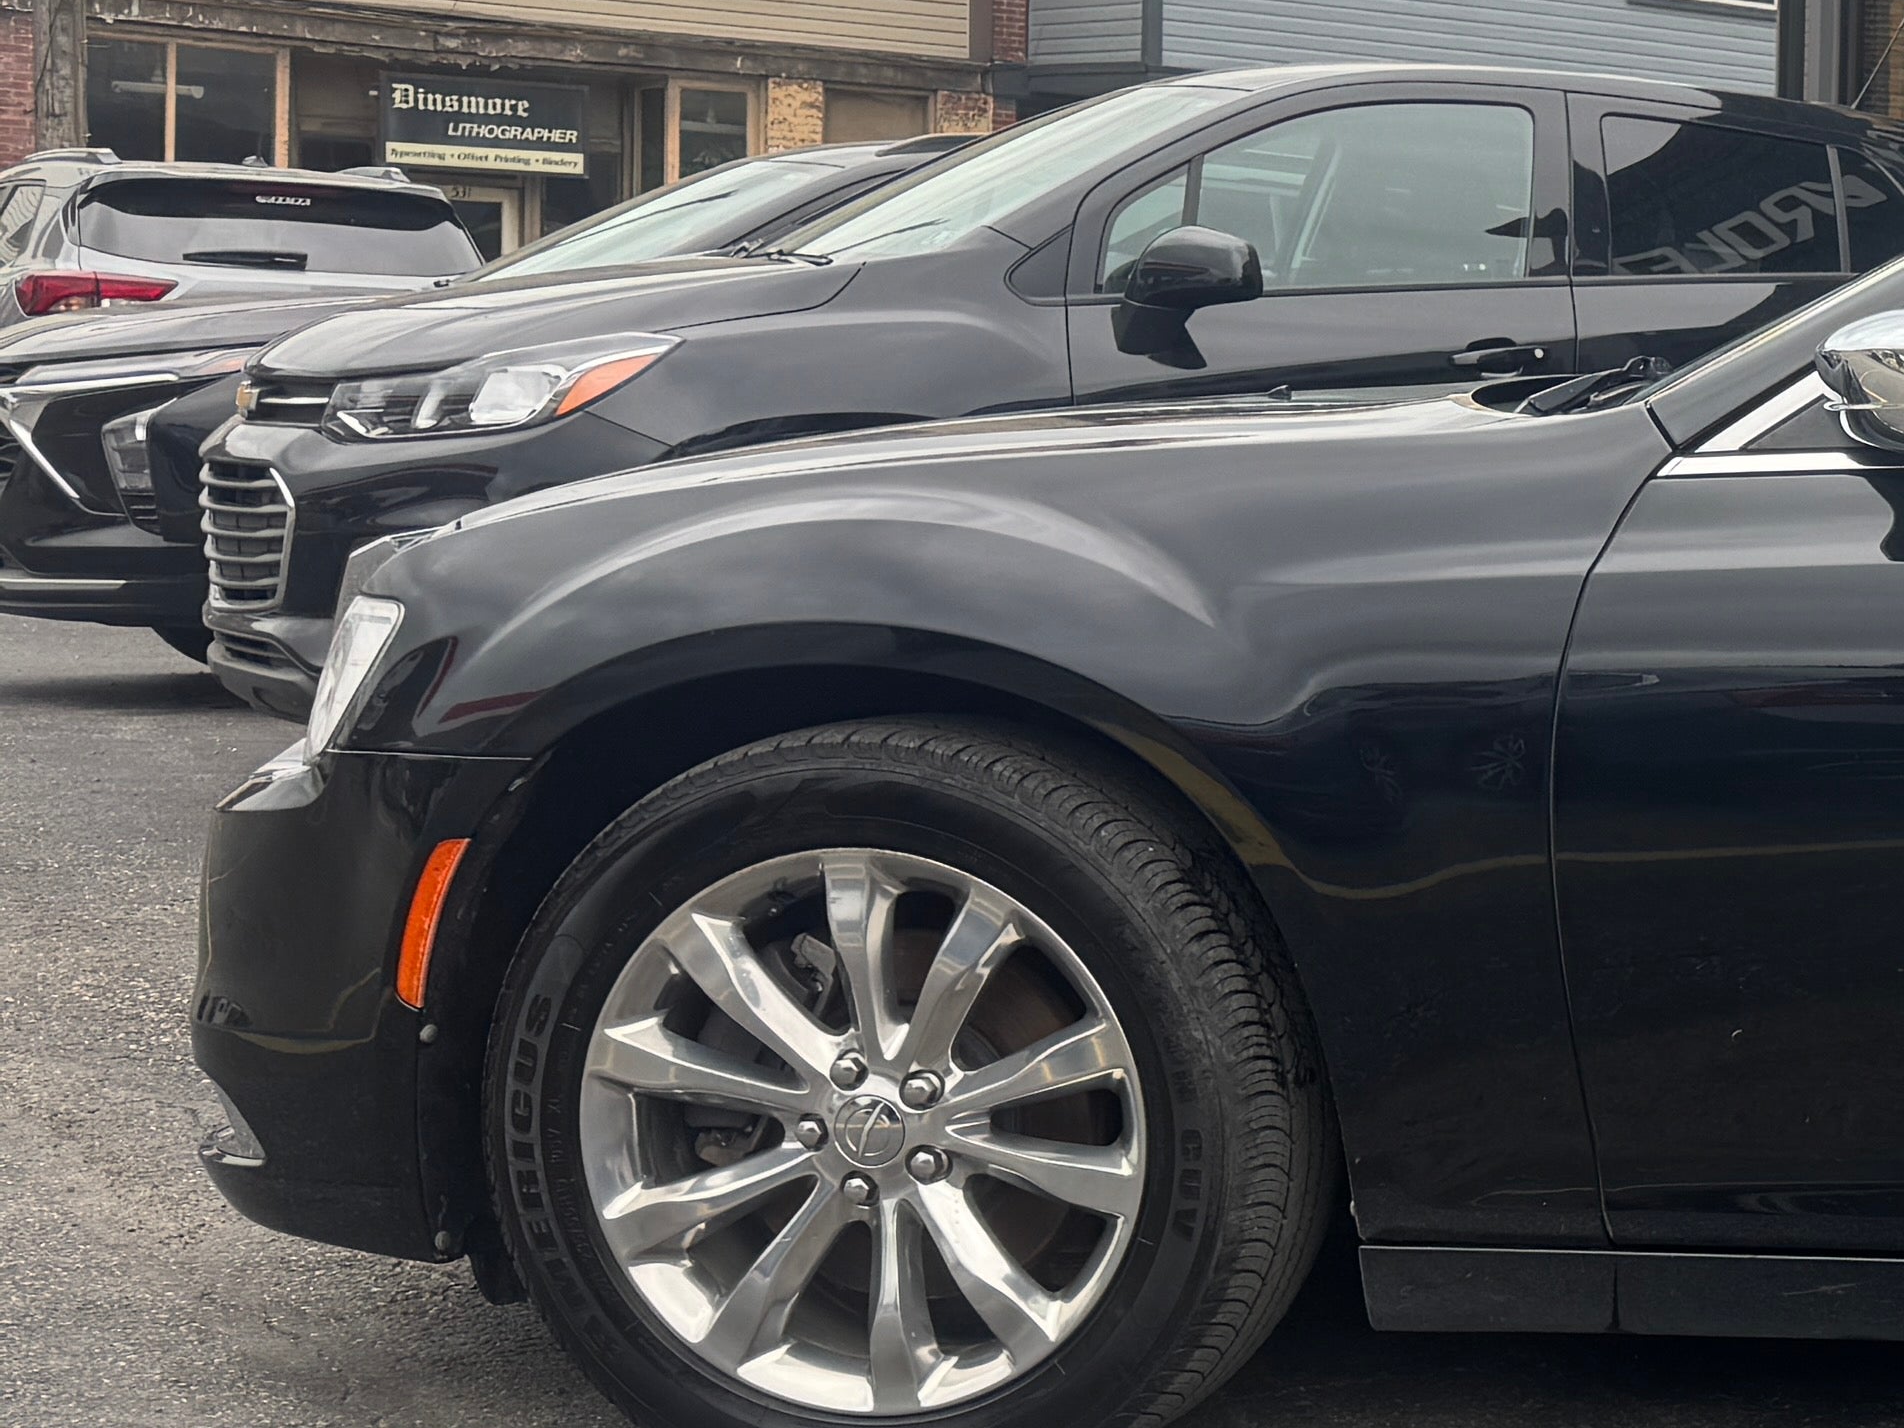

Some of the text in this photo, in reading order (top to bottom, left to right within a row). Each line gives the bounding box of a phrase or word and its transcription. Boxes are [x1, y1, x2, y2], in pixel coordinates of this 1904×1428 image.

[391, 83, 530, 118] Dinsmore
[448, 122, 578, 143] LITHOGRAPHER
[391, 148, 446, 161] Typesetting
[494, 154, 531, 166] Printing
[541, 158, 579, 169] Bindery
